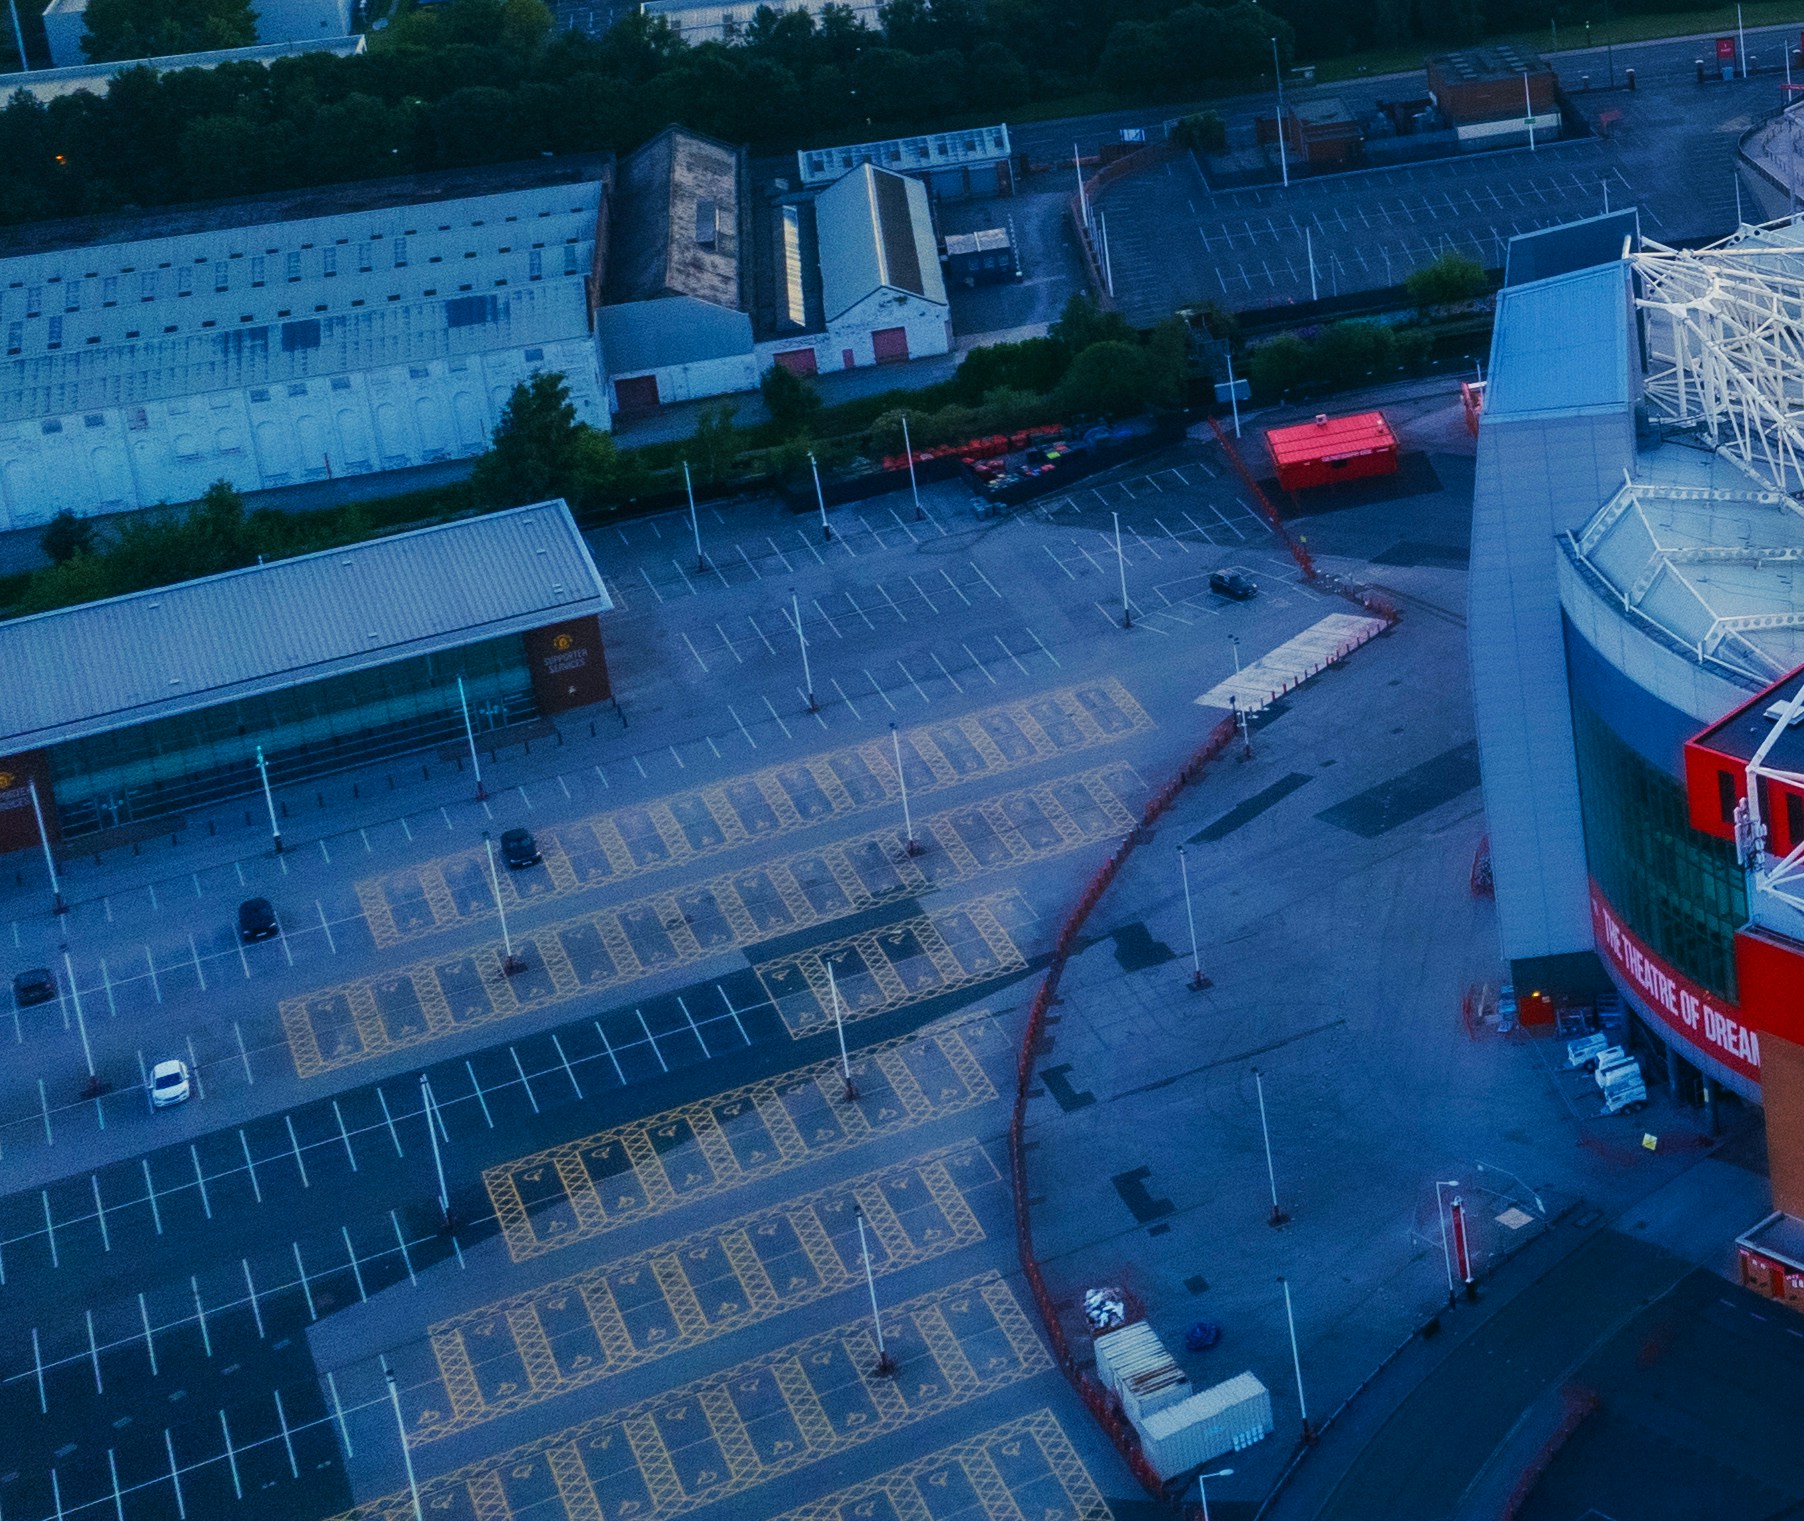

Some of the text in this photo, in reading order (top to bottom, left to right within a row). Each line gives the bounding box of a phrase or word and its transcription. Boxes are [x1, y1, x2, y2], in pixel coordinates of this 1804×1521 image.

[1602, 908, 1622, 961] THE
[1621, 934, 1679, 1016] THEATRE
[1680, 989, 1700, 1030] OF
